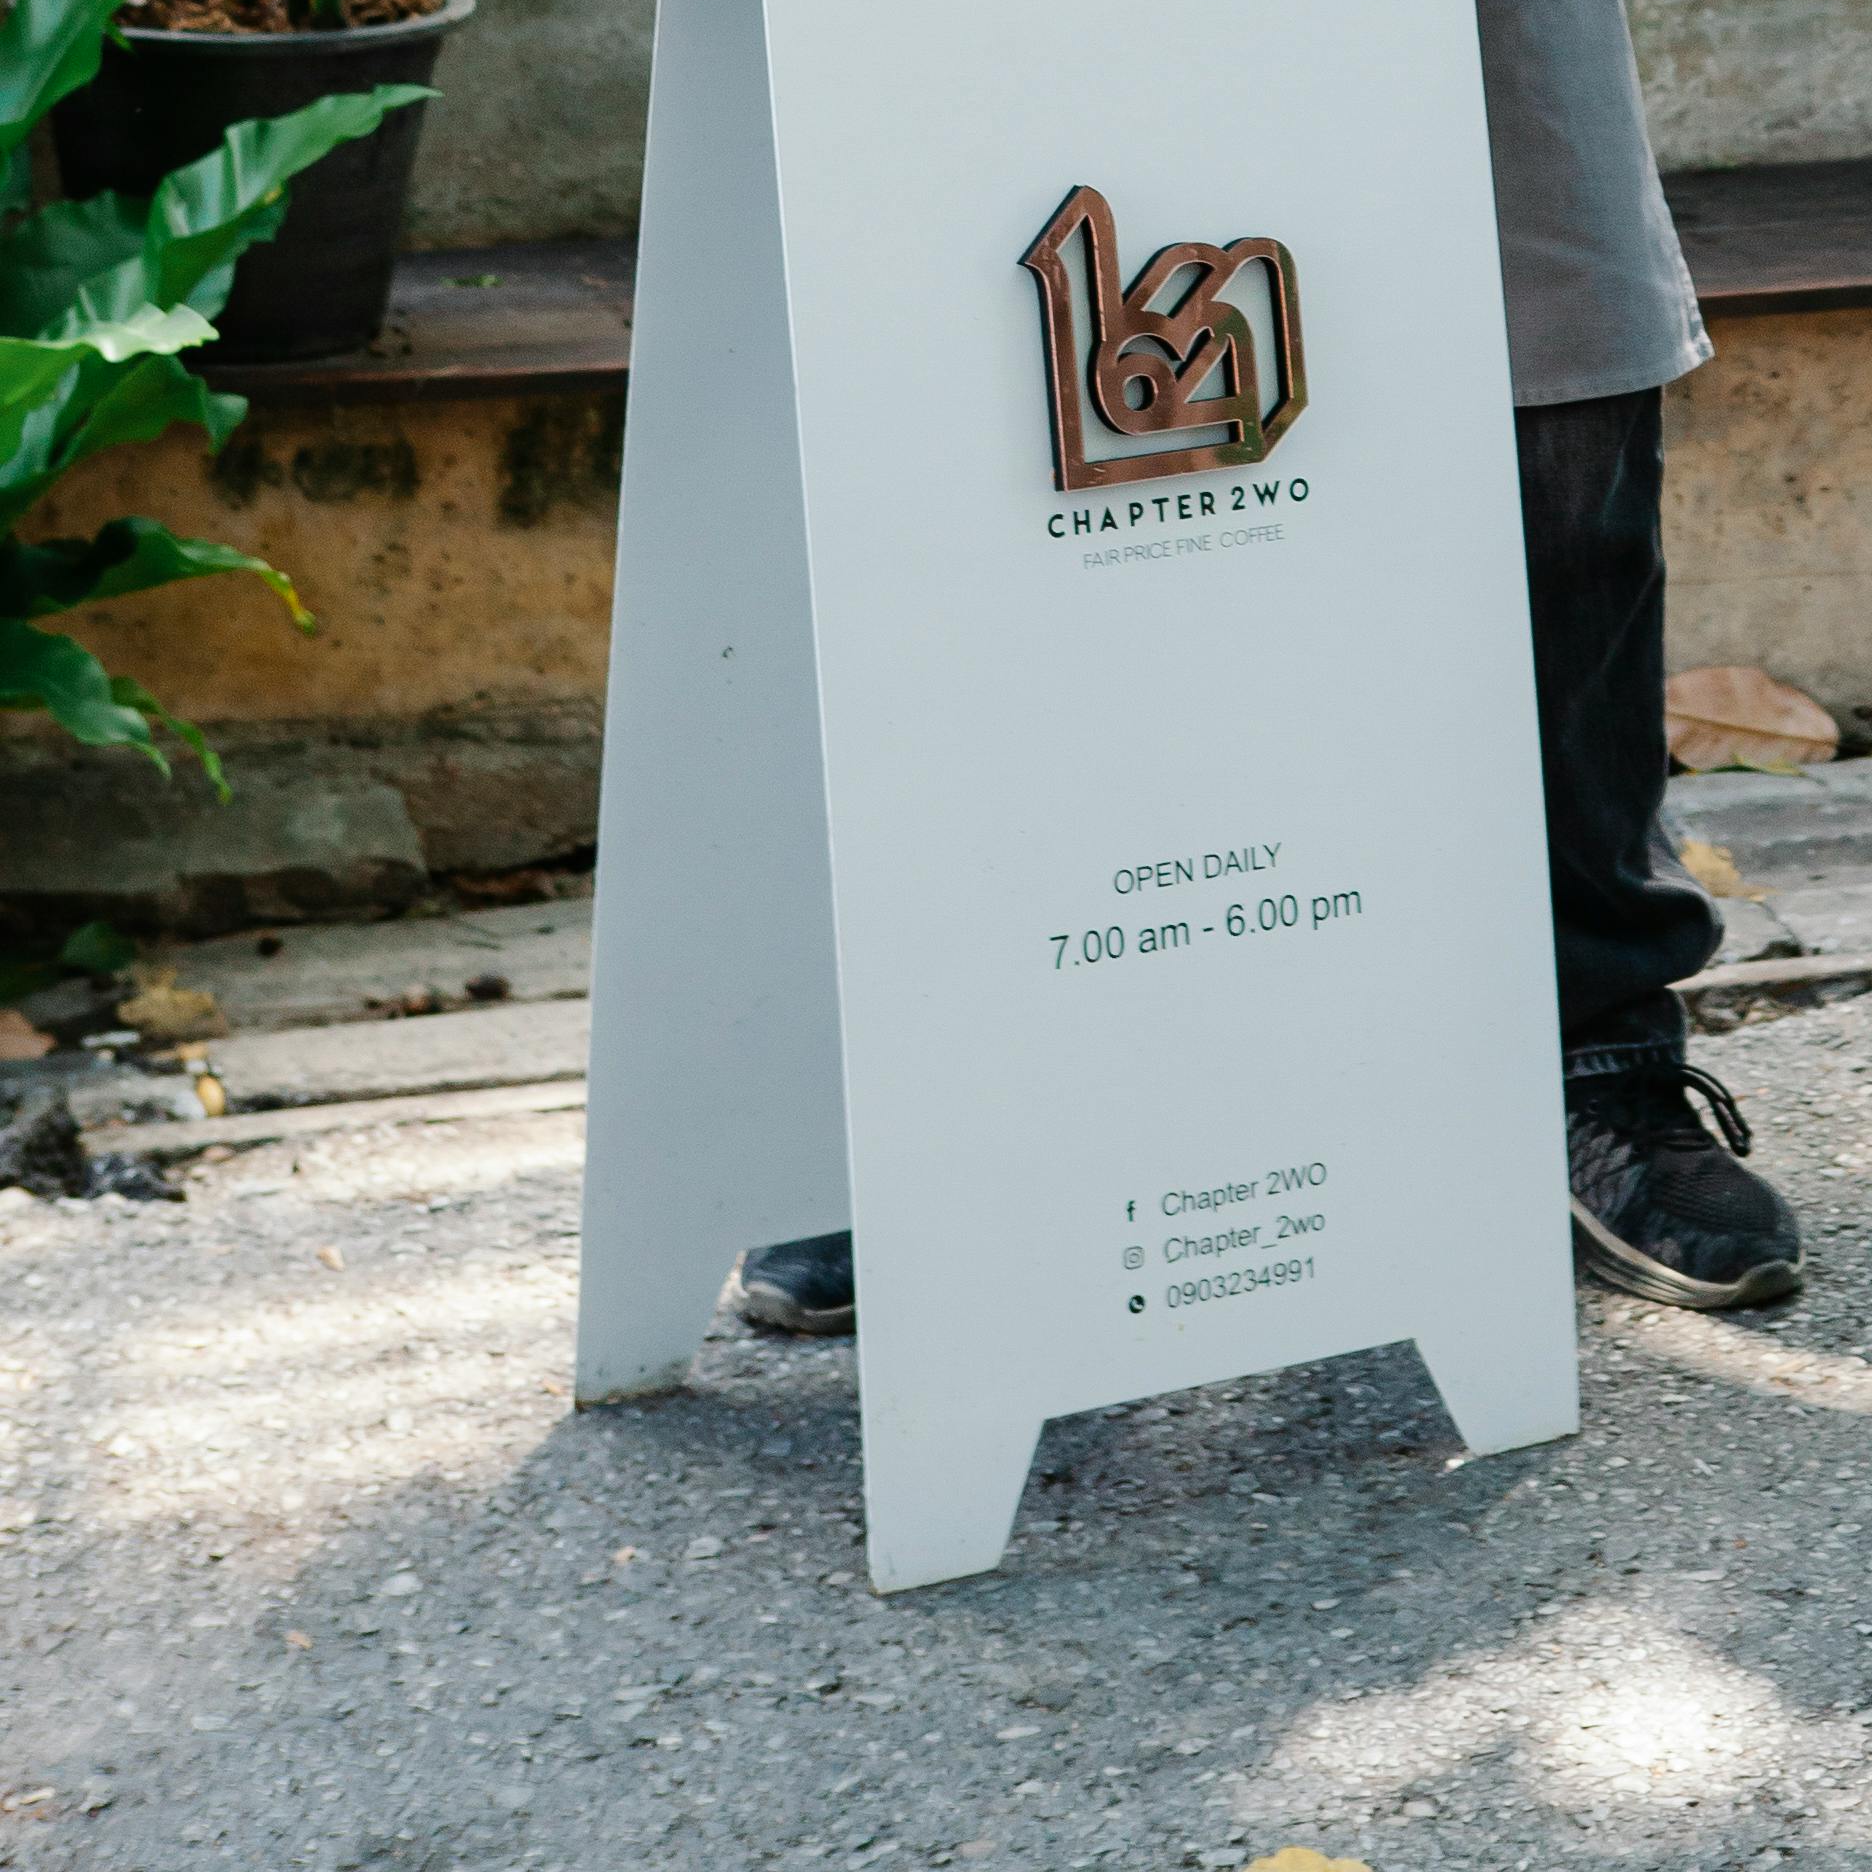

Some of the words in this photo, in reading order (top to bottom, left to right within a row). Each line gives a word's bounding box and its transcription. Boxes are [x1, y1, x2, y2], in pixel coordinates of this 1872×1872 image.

[1047, 491, 1216, 539] CHAPTER
[1230, 478, 1310, 511] 2WO
[1082, 548, 1121, 570] FAIR
[1123, 539, 1172, 563] PRICE
[1176, 534, 1212, 554] FINE
[1220, 523, 1285, 548] COFFEE
[1113, 857, 1194, 895] OPEN
[1203, 841, 1282, 879] DAILY
[1048, 925, 1125, 970] 7.00
[1138, 920, 1191, 954] am
[1225, 893, 1299, 937] 6.00
[1311, 889, 1363, 930] pm
[1161, 1180, 1260, 1217] Chapter
[1265, 1161, 1328, 1196] 2WO
[1164, 1213, 1326, 1264] Chapter_2wo
[1166, 1255, 1315, 1309] 0903234991
